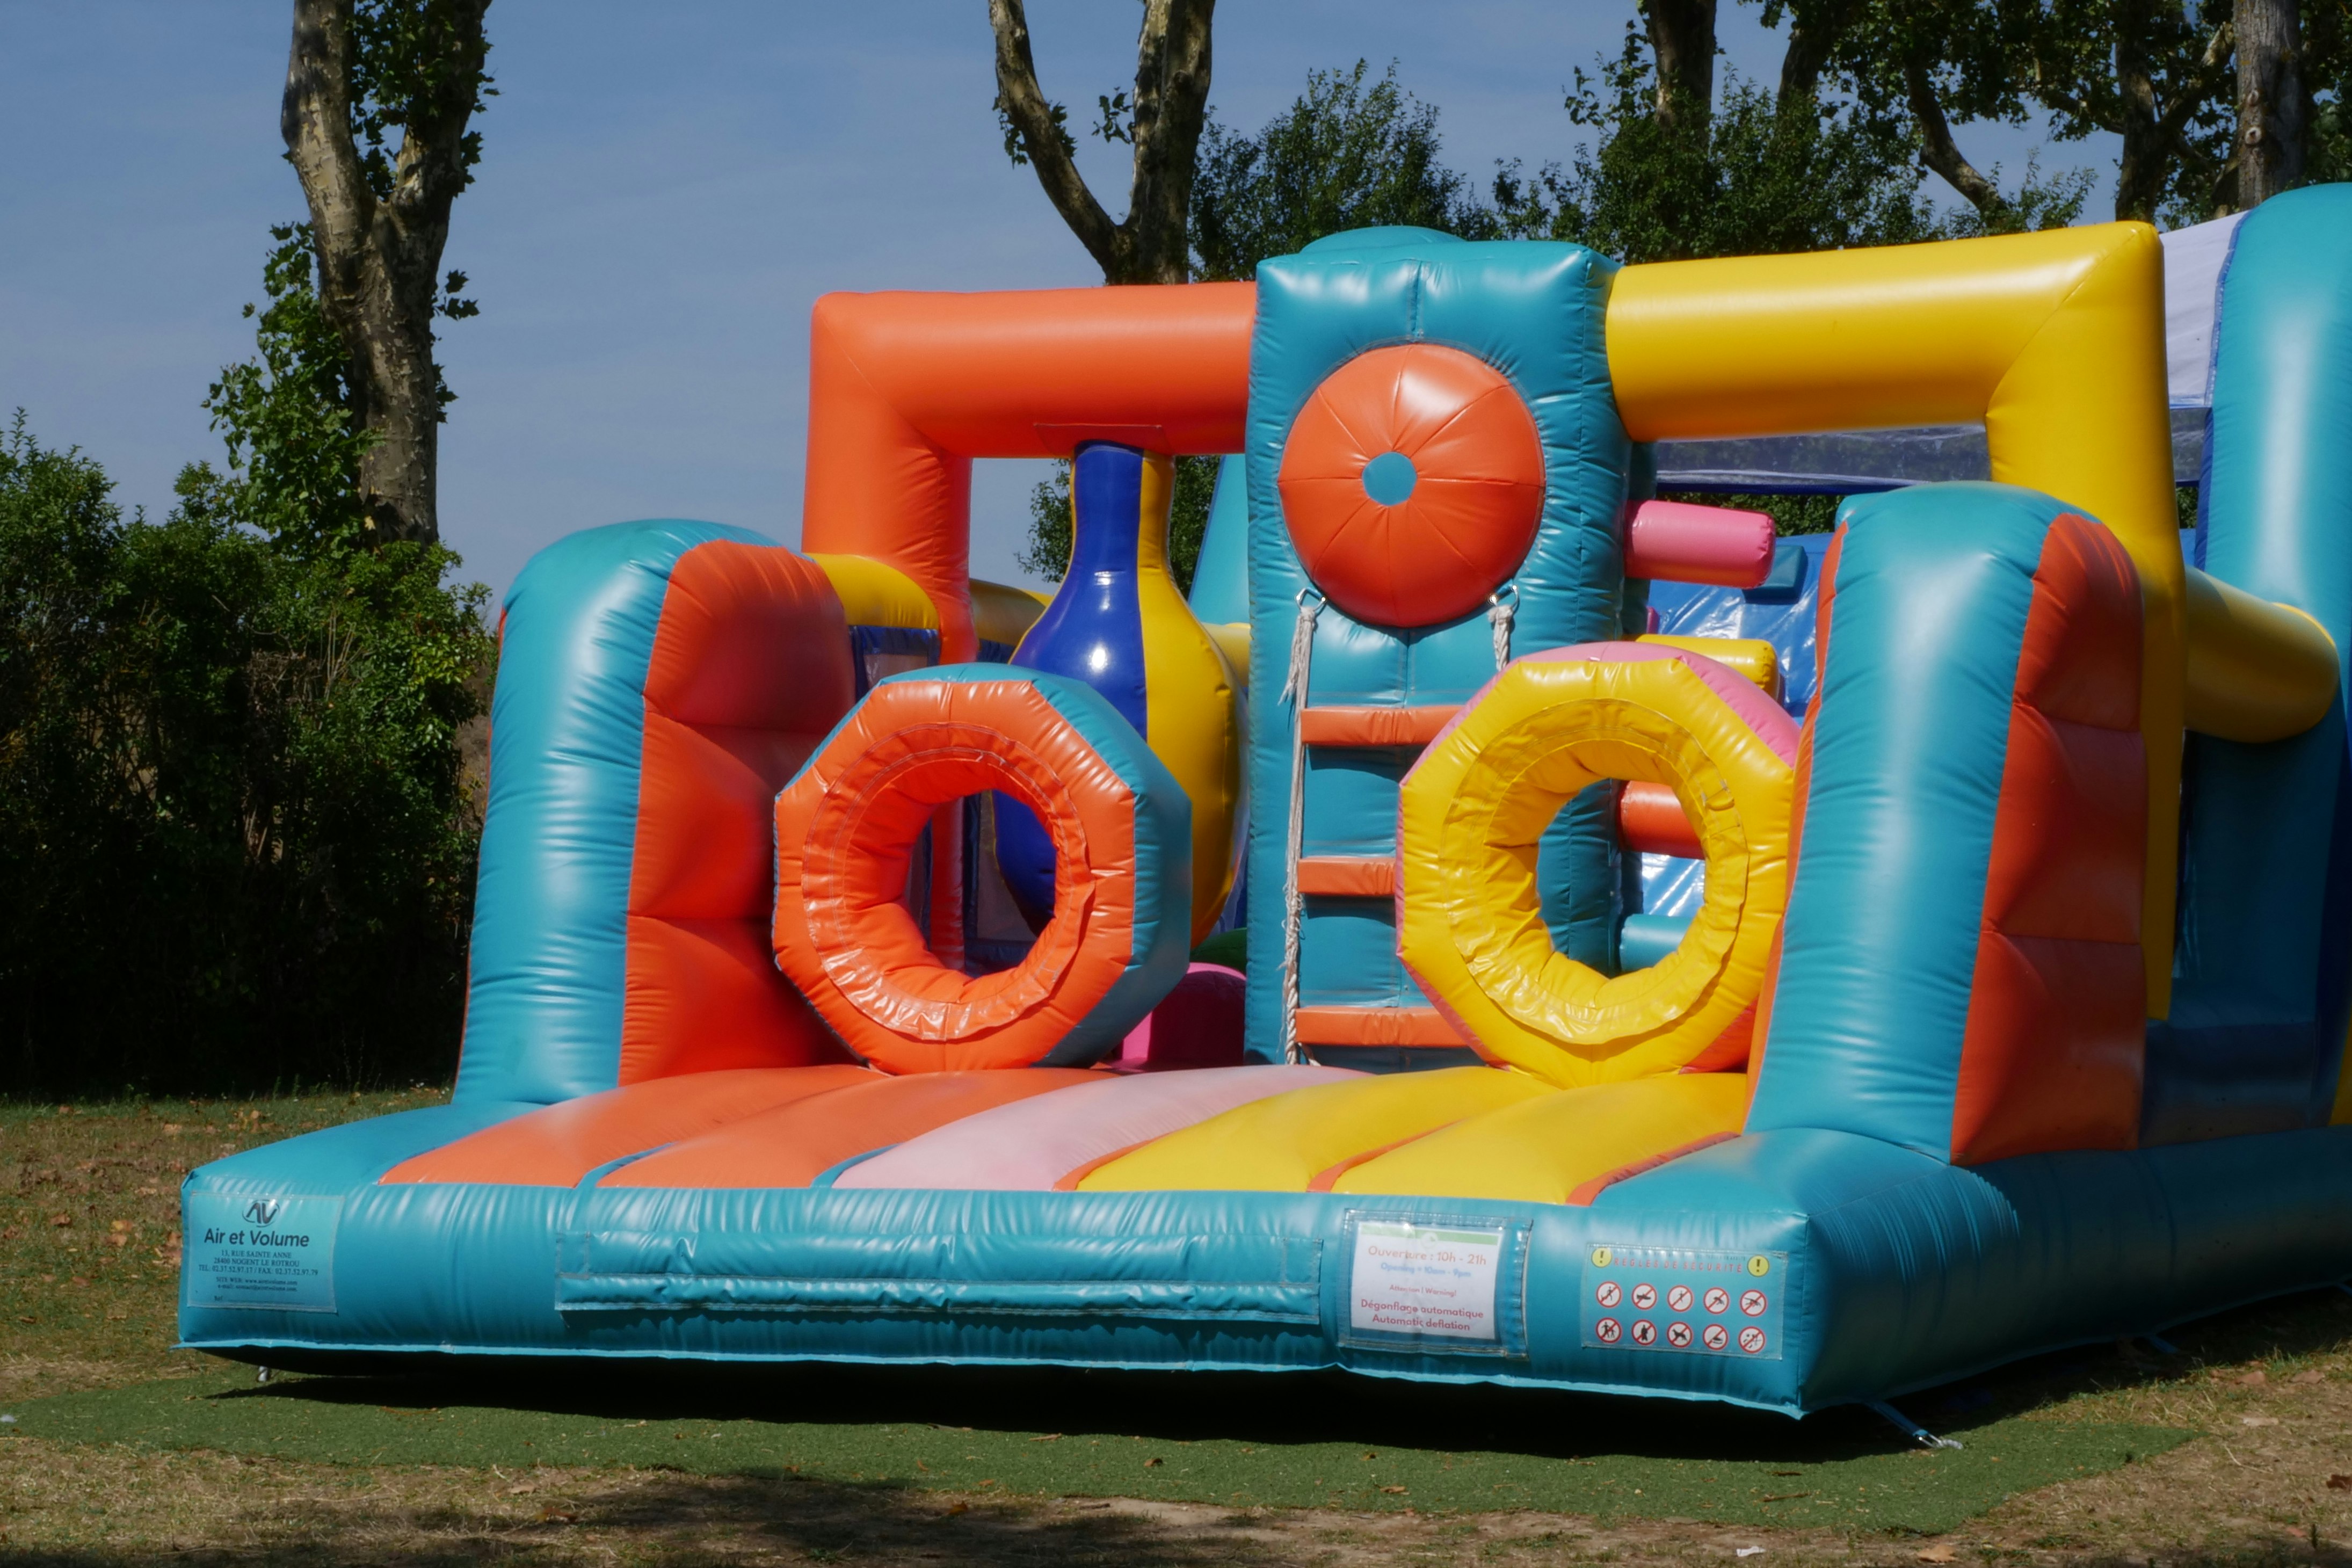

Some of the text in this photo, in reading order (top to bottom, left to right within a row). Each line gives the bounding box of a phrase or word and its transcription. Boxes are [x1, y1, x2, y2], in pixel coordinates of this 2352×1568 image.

[204, 1228, 310, 1247] Air et Volume
[232, 1258, 259, 1266] NOGENT
[1368, 1245, 1427, 1260] Ouverture
[1437, 1251, 1456, 1262] 10h
[1467, 1253, 1486, 1265] 21h
[1380, 1262, 1415, 1275] Opening
[1452, 1268, 1471, 1279] 9pm
[1664, 1259, 1678, 1269] DE
[1389, 1284, 1420, 1293] Attention
[1361, 1298, 1484, 1320] Dégonflage automatique
[1372, 1313, 1471, 1331] Automatic deflation
